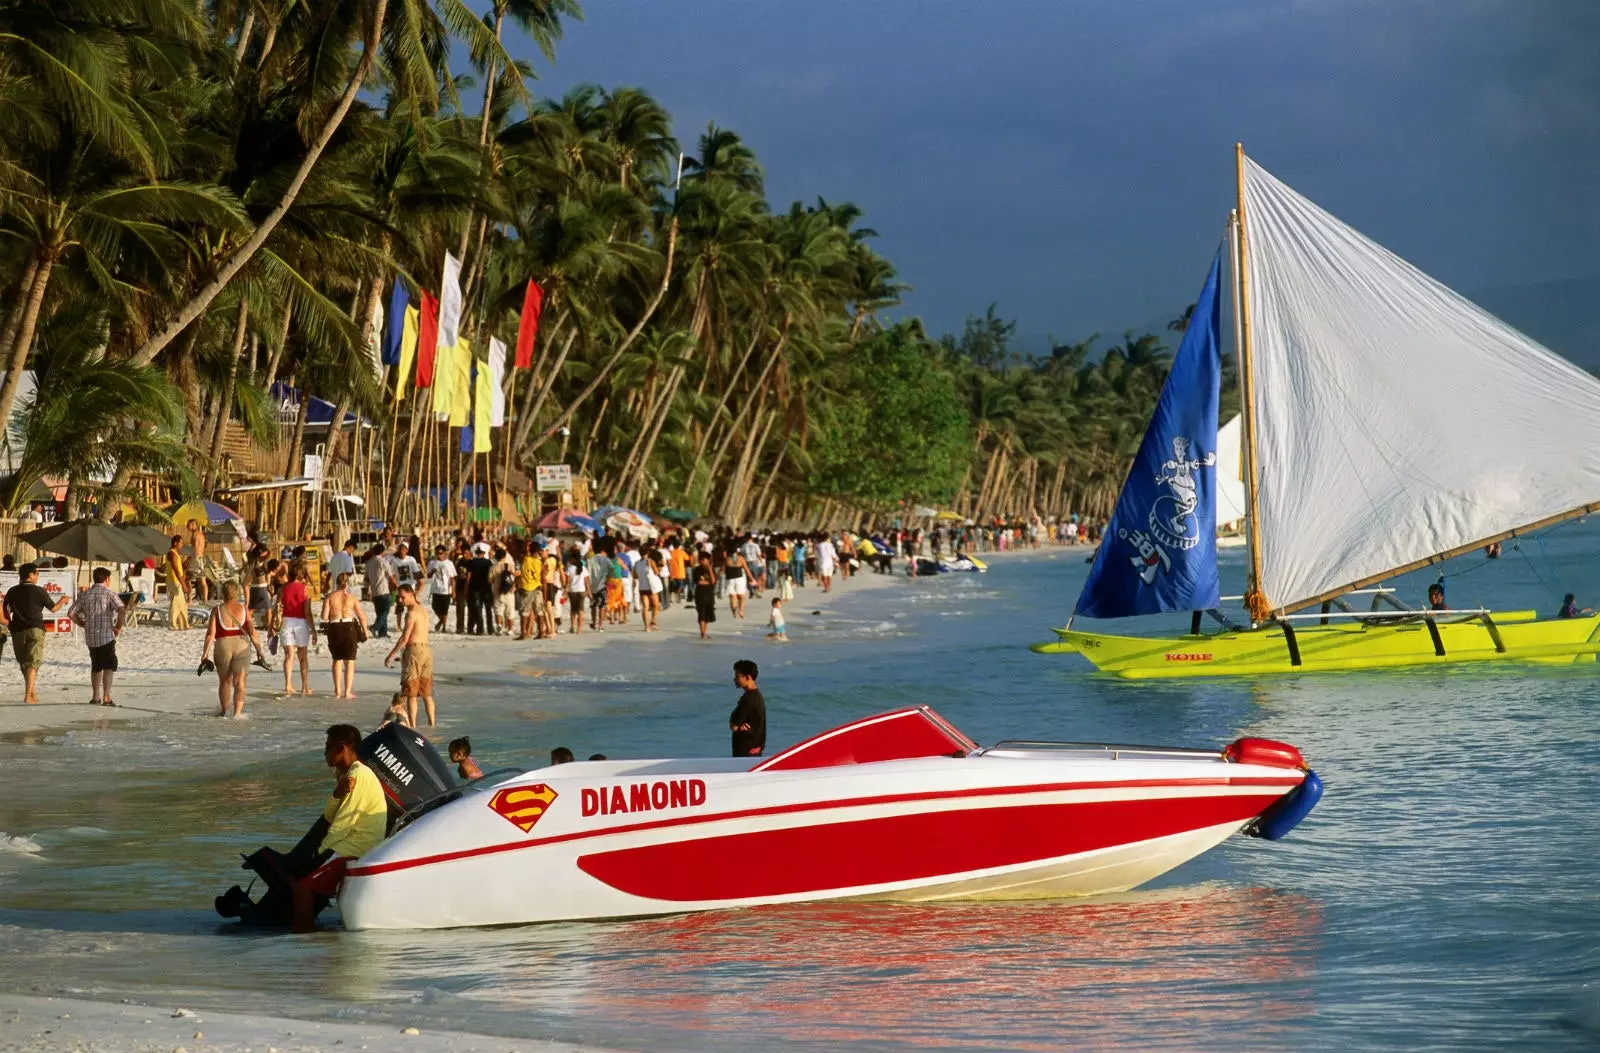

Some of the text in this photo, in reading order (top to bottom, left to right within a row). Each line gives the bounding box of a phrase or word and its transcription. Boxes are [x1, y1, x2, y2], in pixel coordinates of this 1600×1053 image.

[1165, 653, 1213, 662] KOBE
[374, 743, 414, 786] YAMAHA
[580, 778, 707, 818] DIAMOND
